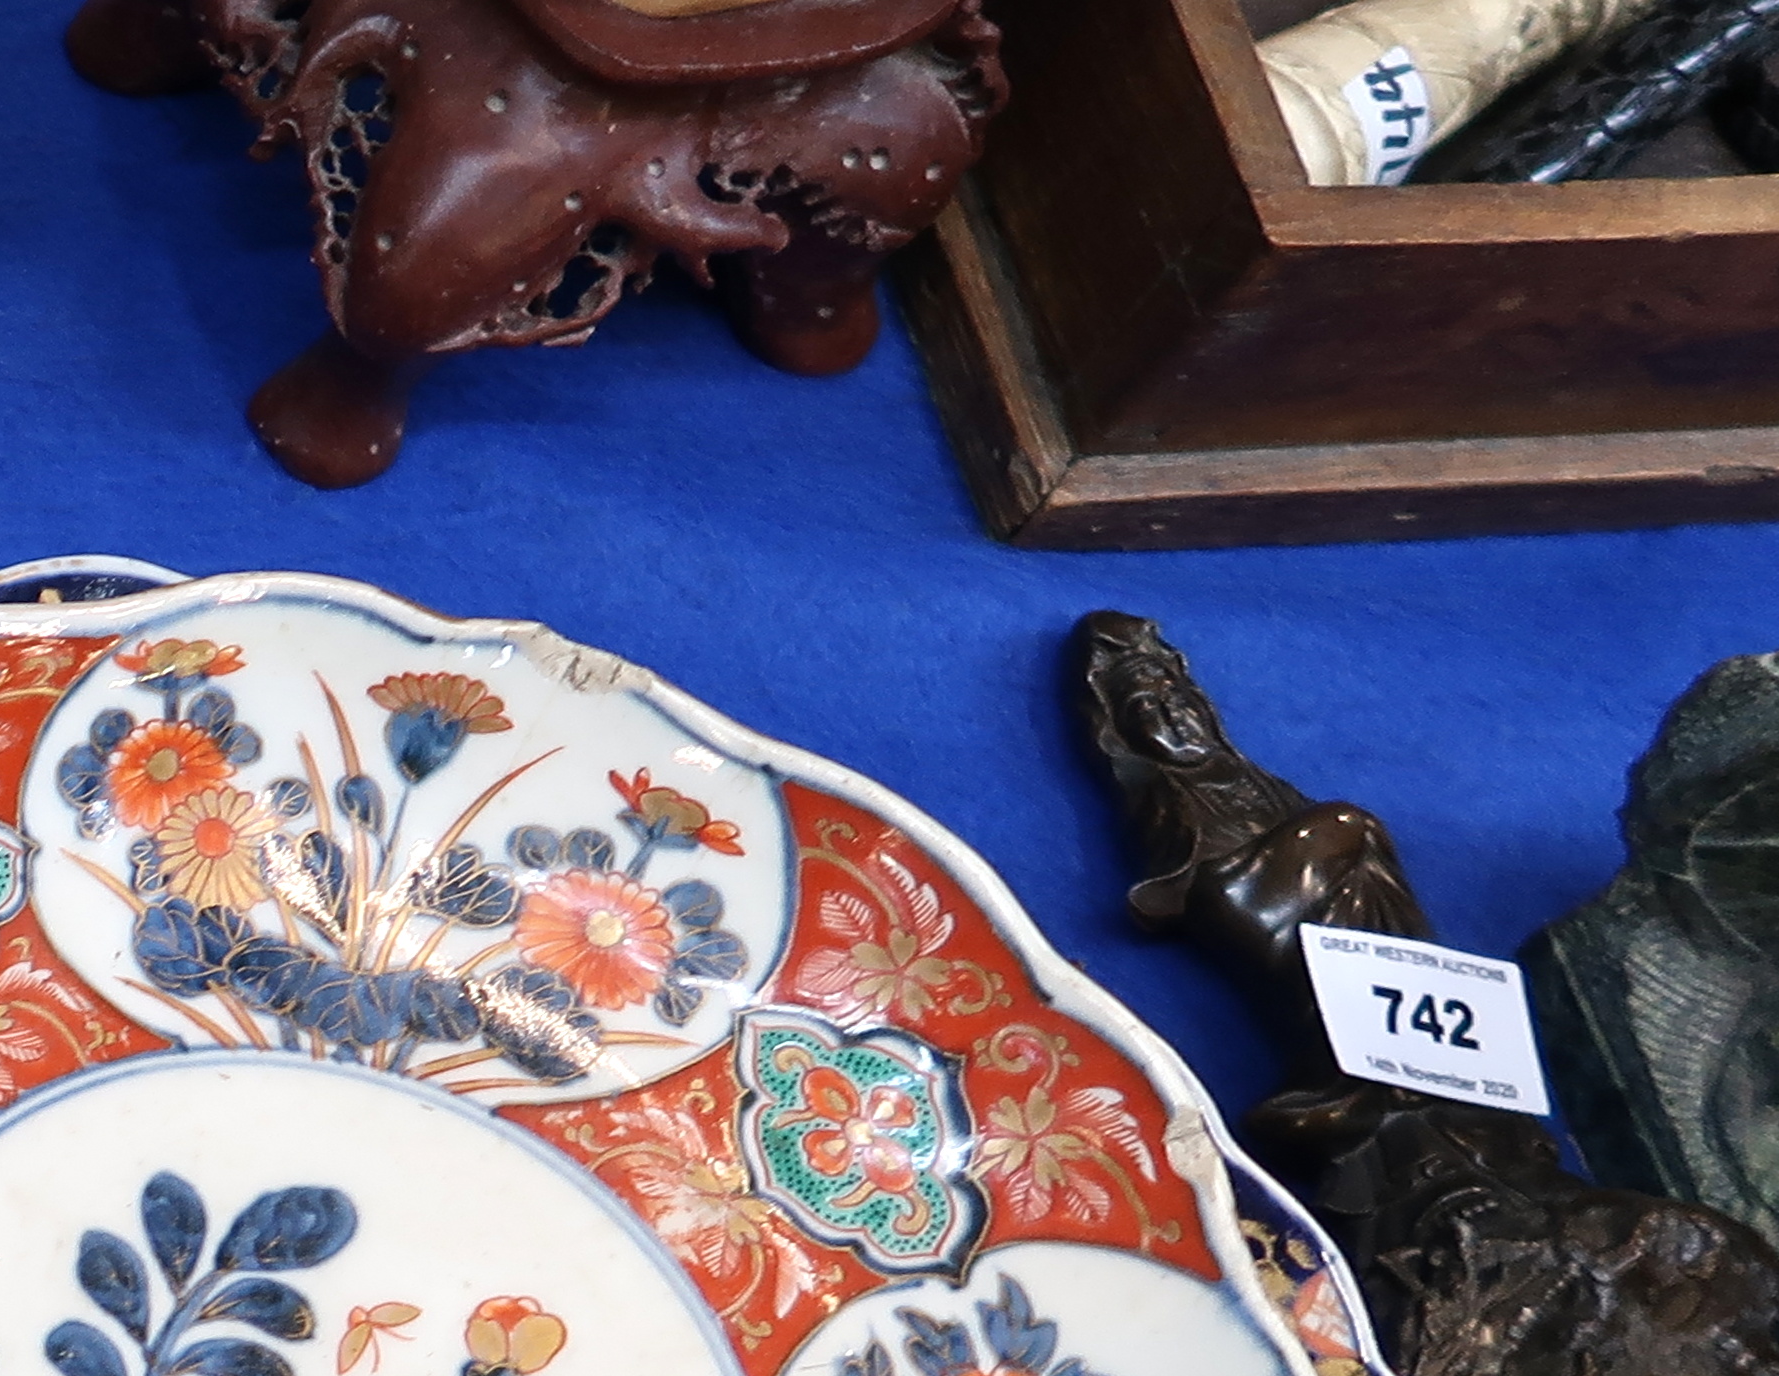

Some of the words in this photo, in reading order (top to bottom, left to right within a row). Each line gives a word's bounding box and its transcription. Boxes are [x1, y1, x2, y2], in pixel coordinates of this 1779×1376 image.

[1320, 936, 1369, 953] GREAT
[1374, 946, 1439, 968] WESTERN
[1442, 959, 1507, 983] AUCTIONS
[1371, 984, 1480, 1050] 742
[1401, 1063, 1477, 1090] November
[1480, 1079, 1518, 1099] 2020
